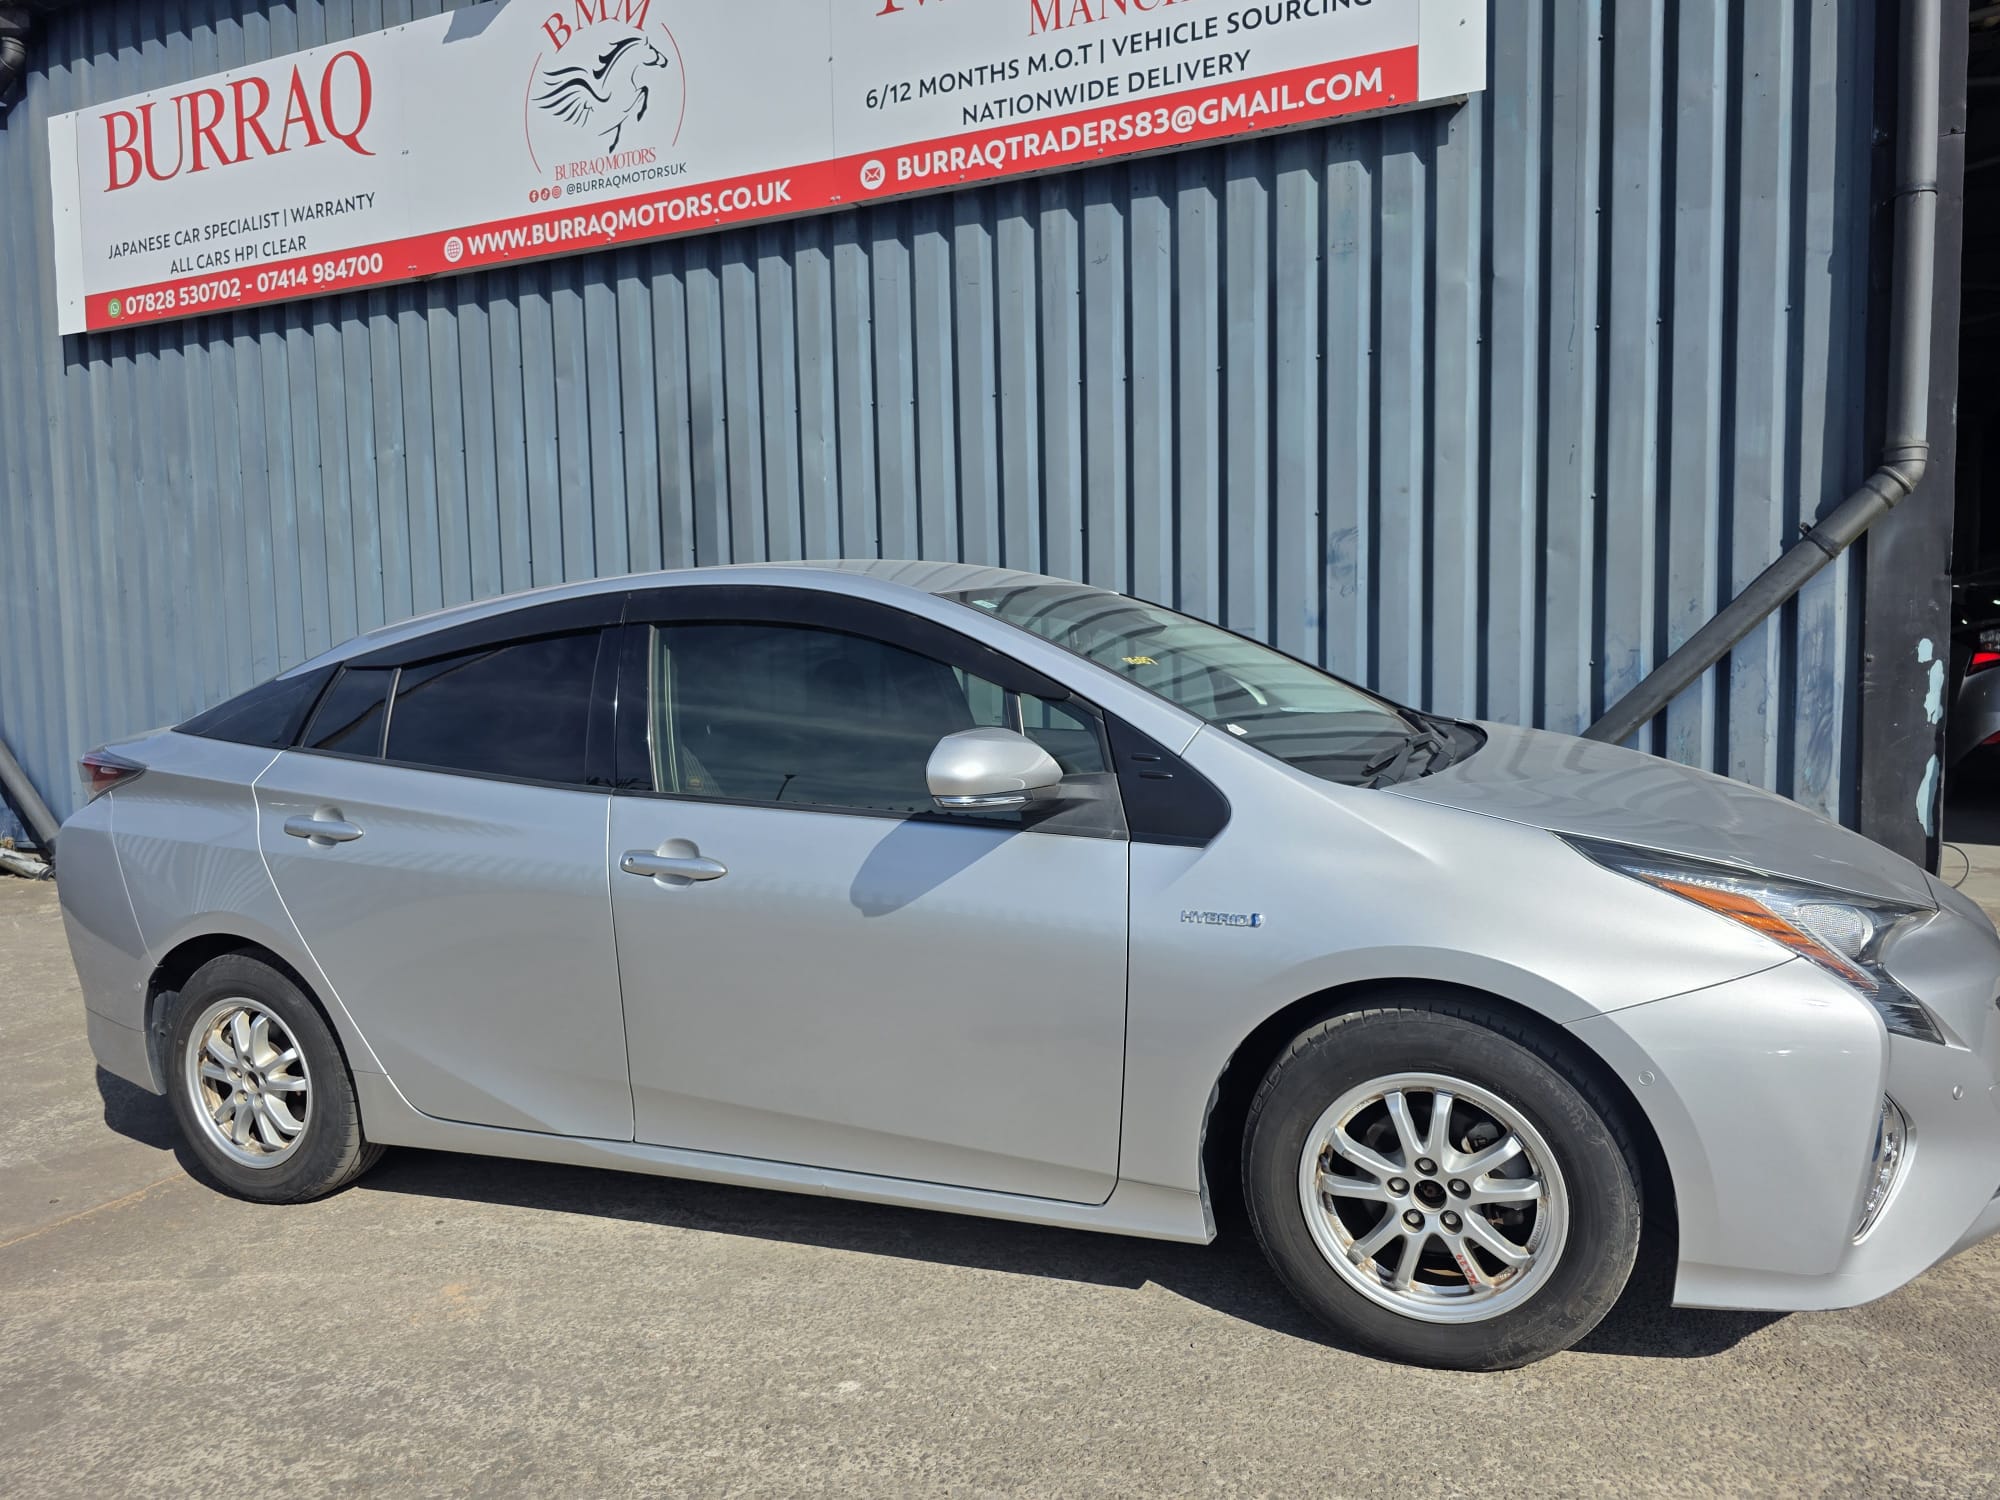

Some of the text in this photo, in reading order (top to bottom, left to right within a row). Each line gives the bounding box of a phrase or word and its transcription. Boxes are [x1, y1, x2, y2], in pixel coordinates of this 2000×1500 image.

[541, 0, 651, 53] BMM
[866, 82, 911, 110] 6/12
[919, 59, 1019, 98] MONTHS
[1028, 43, 1092, 76] M.O.T
[1112, 16, 1218, 57] VEHICLE
[963, 49, 1251, 125] NATIONWIDE DELIVERY
[100, 50, 376, 192] BURRAQ
[898, 67, 1382, 181] BURRAQTRADERS83@GMAIL.COM
[566, 162, 687, 195] @BURRAQMOTORSUK
[108, 233, 170, 260] JAPANESE
[174, 228, 200, 247] CAR
[204, 212, 279, 241] SPECIALIST
[290, 192, 375, 223] WARRANTY
[467, 179, 792, 255] WWW.BURRAQMOTORS.CO.UK
[126, 289, 176, 316] 07828
[179, 278, 241, 307] 530702
[257, 264, 308, 292] 07414
[312, 252, 383, 283] 984700
[170, 235, 307, 275] ALL CARS HPI CLEAR
[1180, 909, 1249, 928] HYBRID
